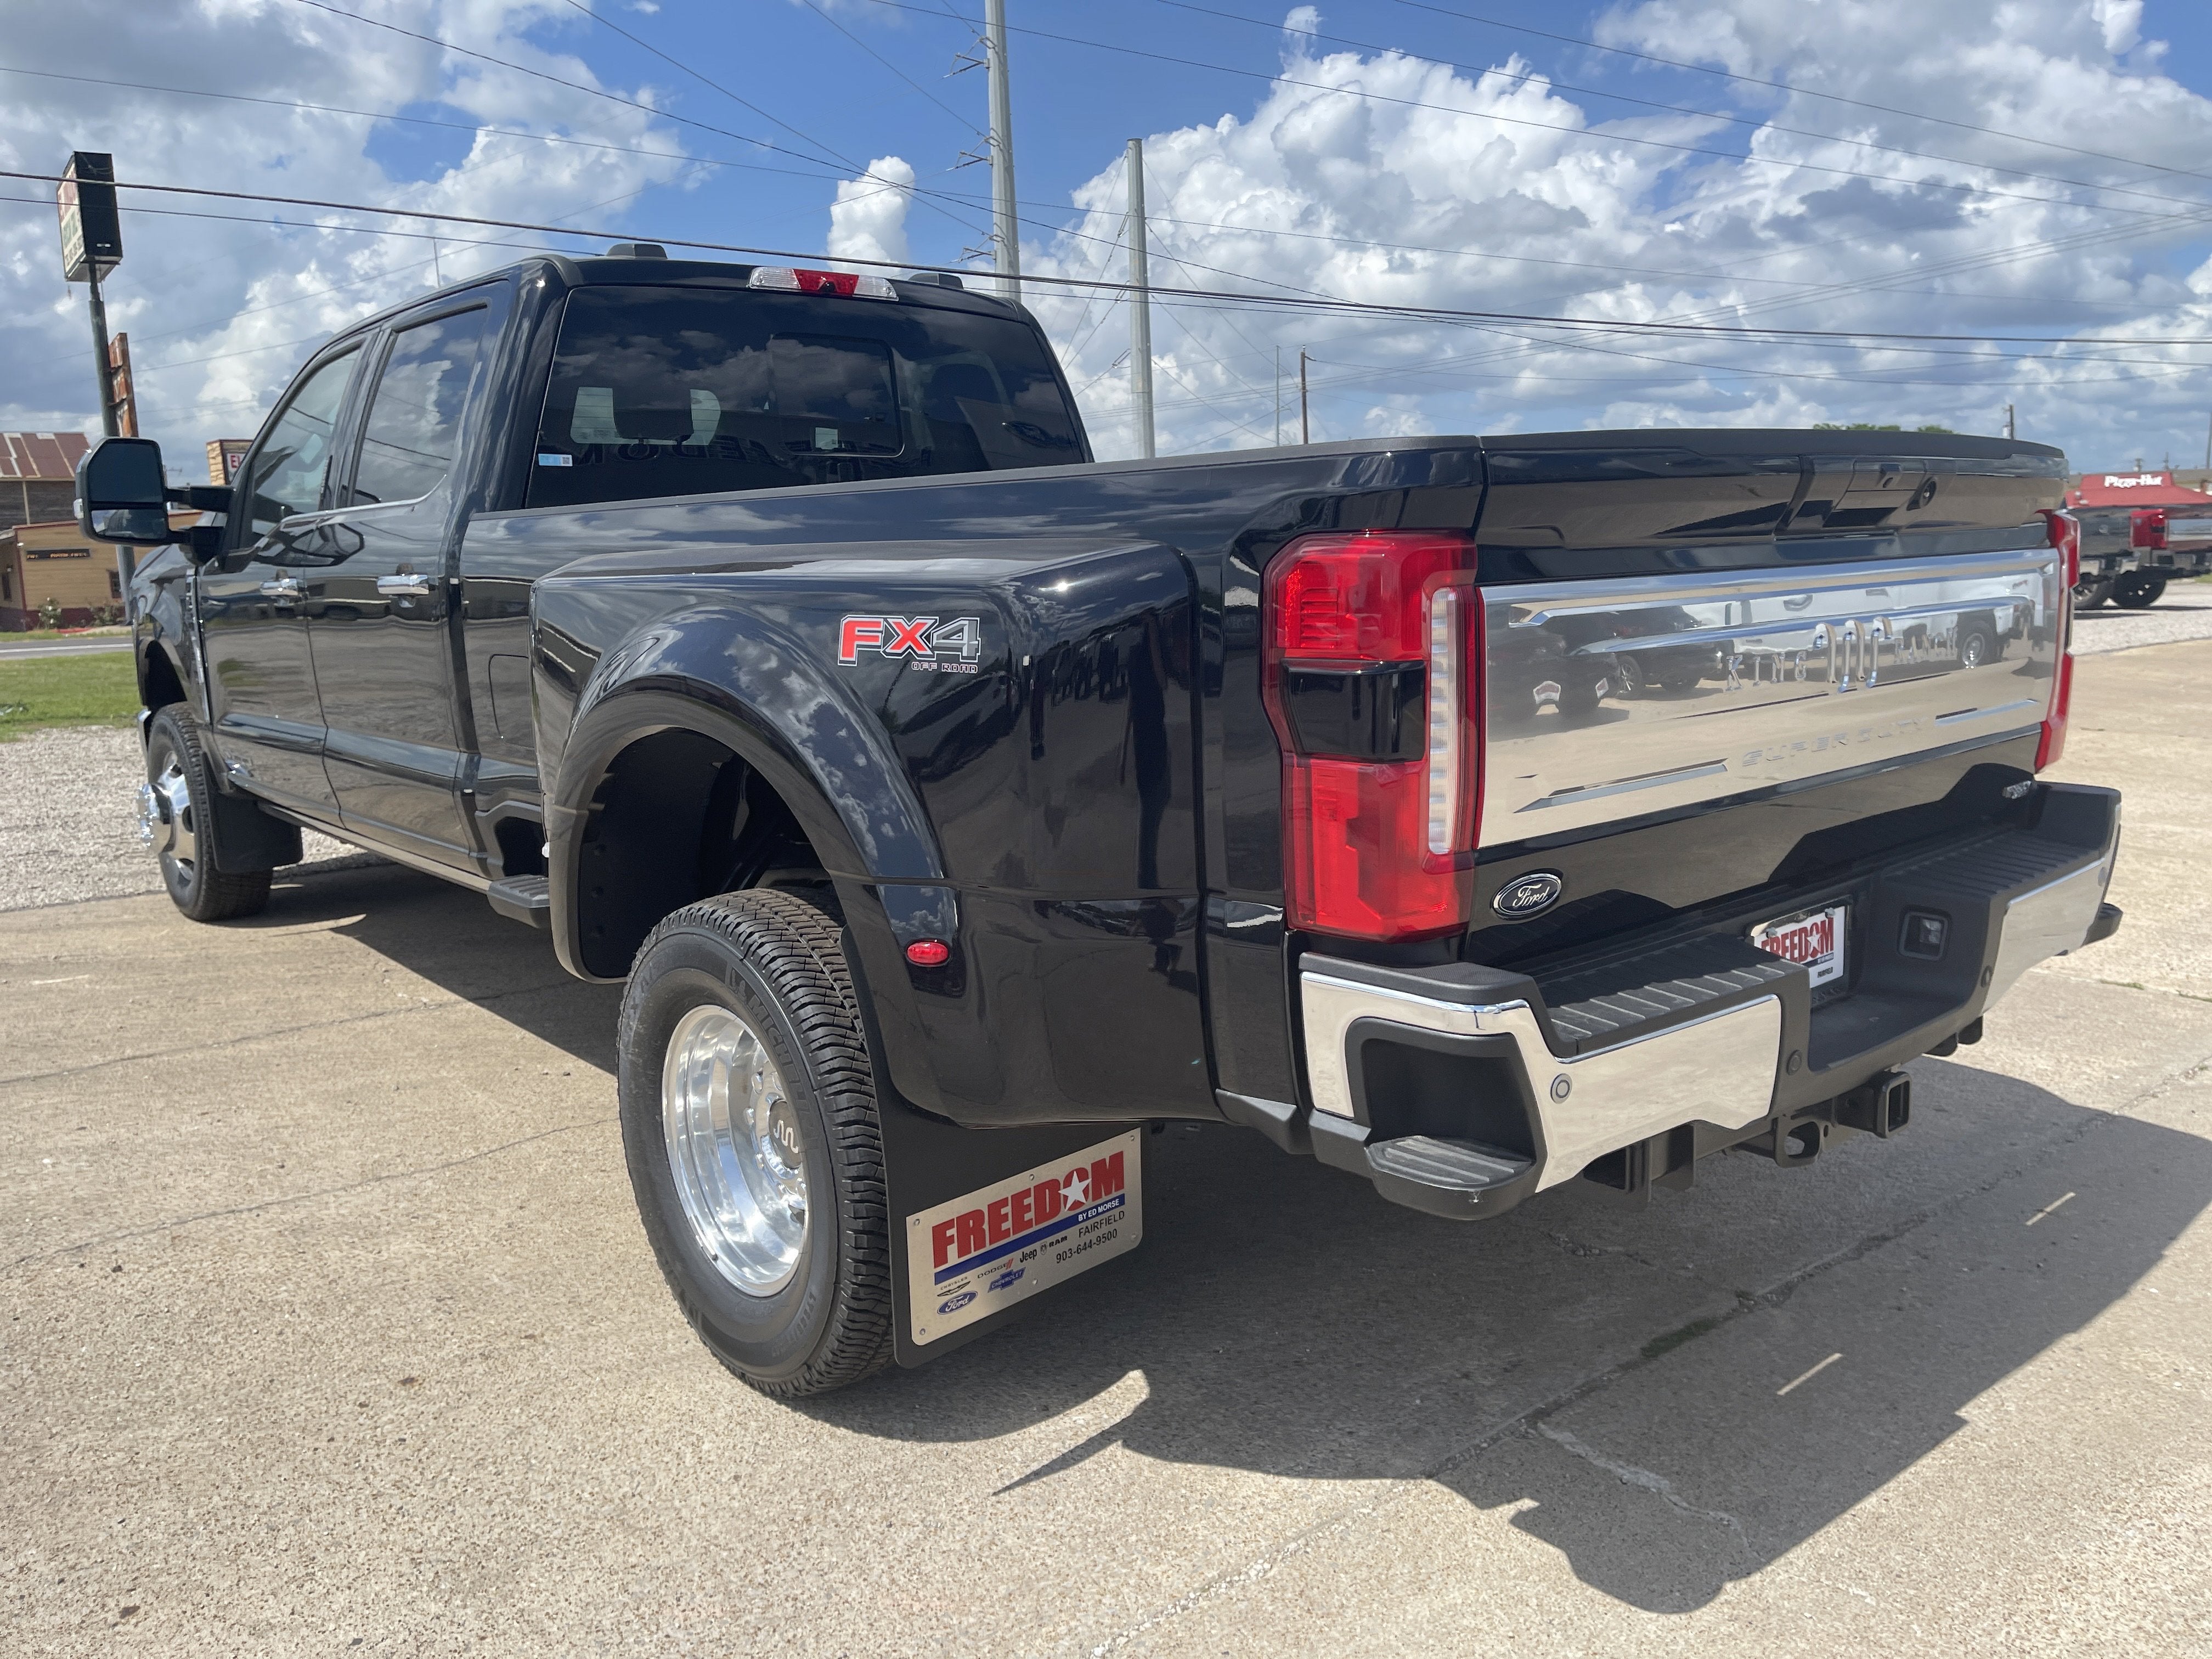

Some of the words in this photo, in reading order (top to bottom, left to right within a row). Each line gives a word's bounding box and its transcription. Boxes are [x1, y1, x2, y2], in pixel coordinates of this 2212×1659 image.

[2104, 475, 2137, 489] Pizza
[837, 614, 981, 667] FX4
[911, 660, 938, 672] OFF
[941, 662, 978, 674] ROAD
[1725, 650, 1808, 692] KING
[1894, 626, 1958, 665] RANCH
[1742, 731, 1848, 768] SUPER
[1512, 883, 1550, 907] Ford
[932, 1150, 1125, 1269] FREEDOM
[1077, 1212, 1087, 1222] BY
[1088, 1208, 1097, 1217] ED
[1098, 1198, 1120, 1214] MORSE
[1079, 1210, 1125, 1238] FAIRFIELD
[1049, 1235, 1068, 1248] RAM
[1056, 1228, 1118, 1264] 903-644-9500
[1019, 1248, 1037, 1263] Jeep
[940, 1276, 968, 1290] CHRYSLER
[991, 1271, 1023, 1289] CHEVROLET
[945, 1294, 970, 1312] Ford
